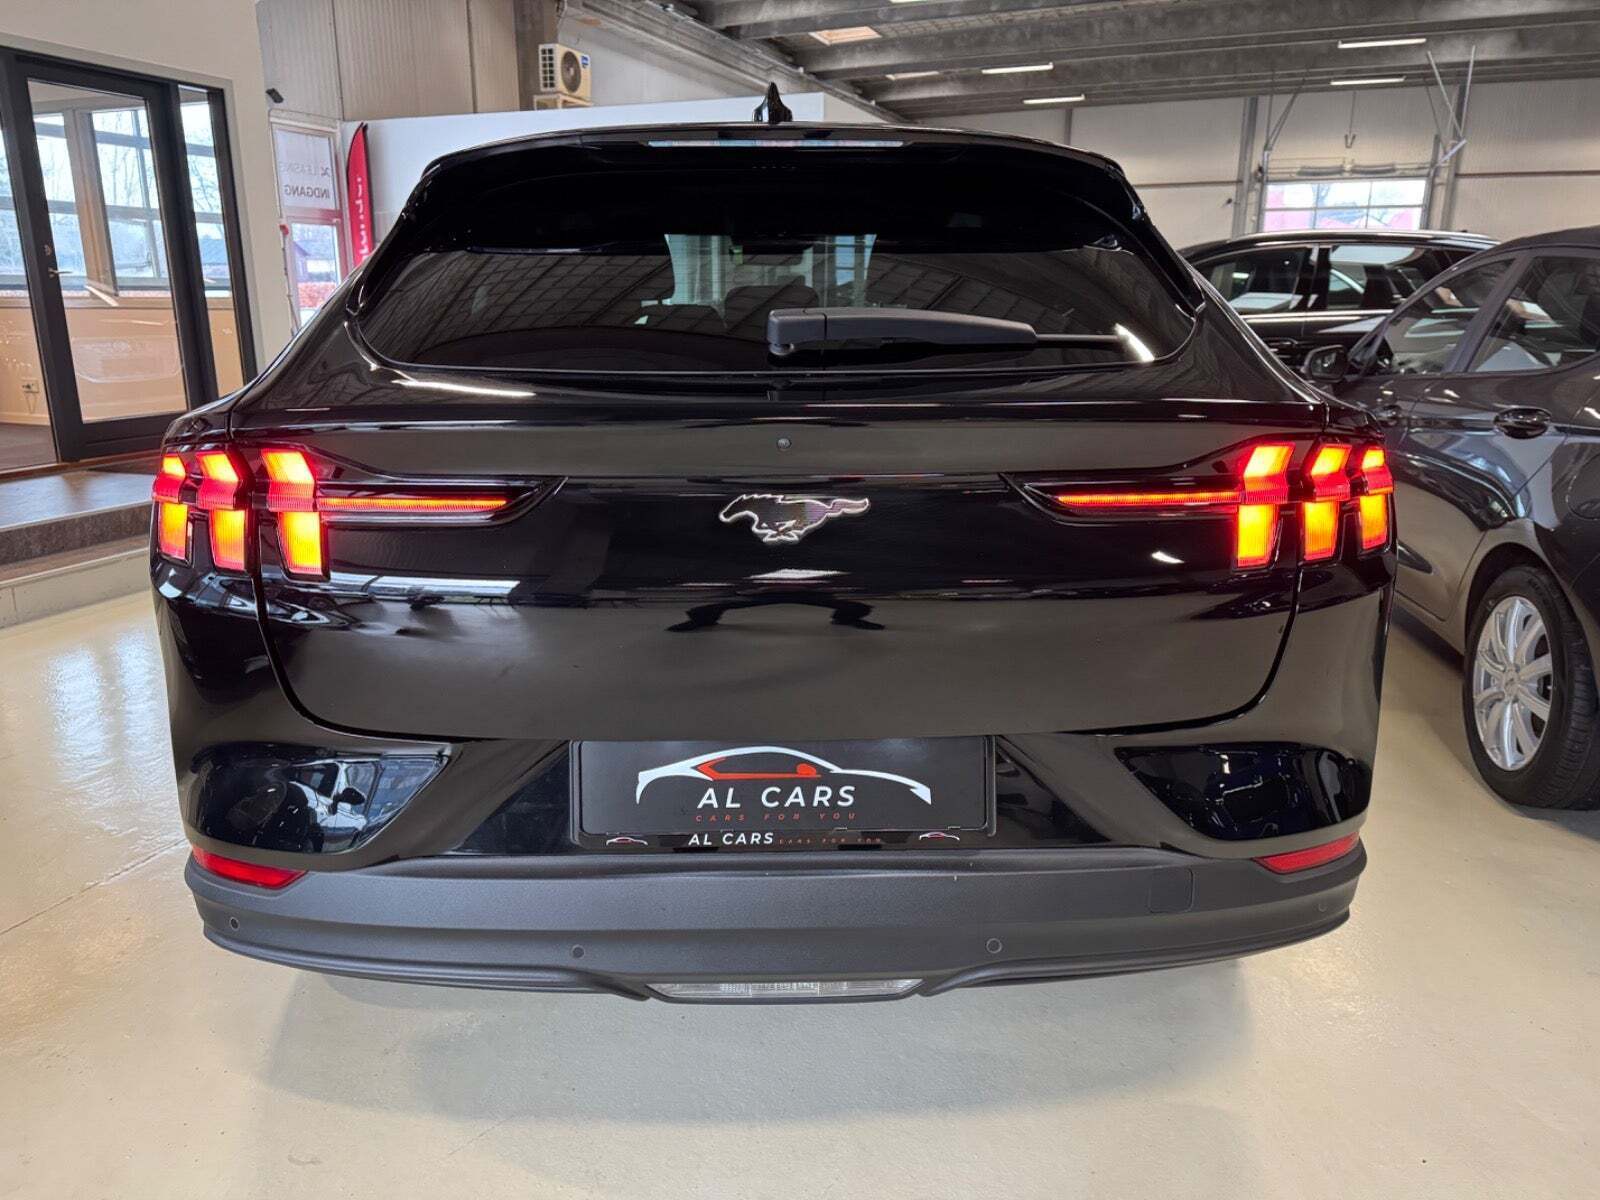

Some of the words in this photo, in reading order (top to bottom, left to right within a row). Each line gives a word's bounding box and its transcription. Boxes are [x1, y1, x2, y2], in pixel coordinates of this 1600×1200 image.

[697, 787, 741, 809] AL
[761, 786, 856, 808] CARS
[695, 814, 746, 822] CARS
[763, 813, 801, 821] FOR
[819, 812, 857, 820] YOU
[688, 833, 713, 846] AL
[722, 833, 774, 845] CARS
